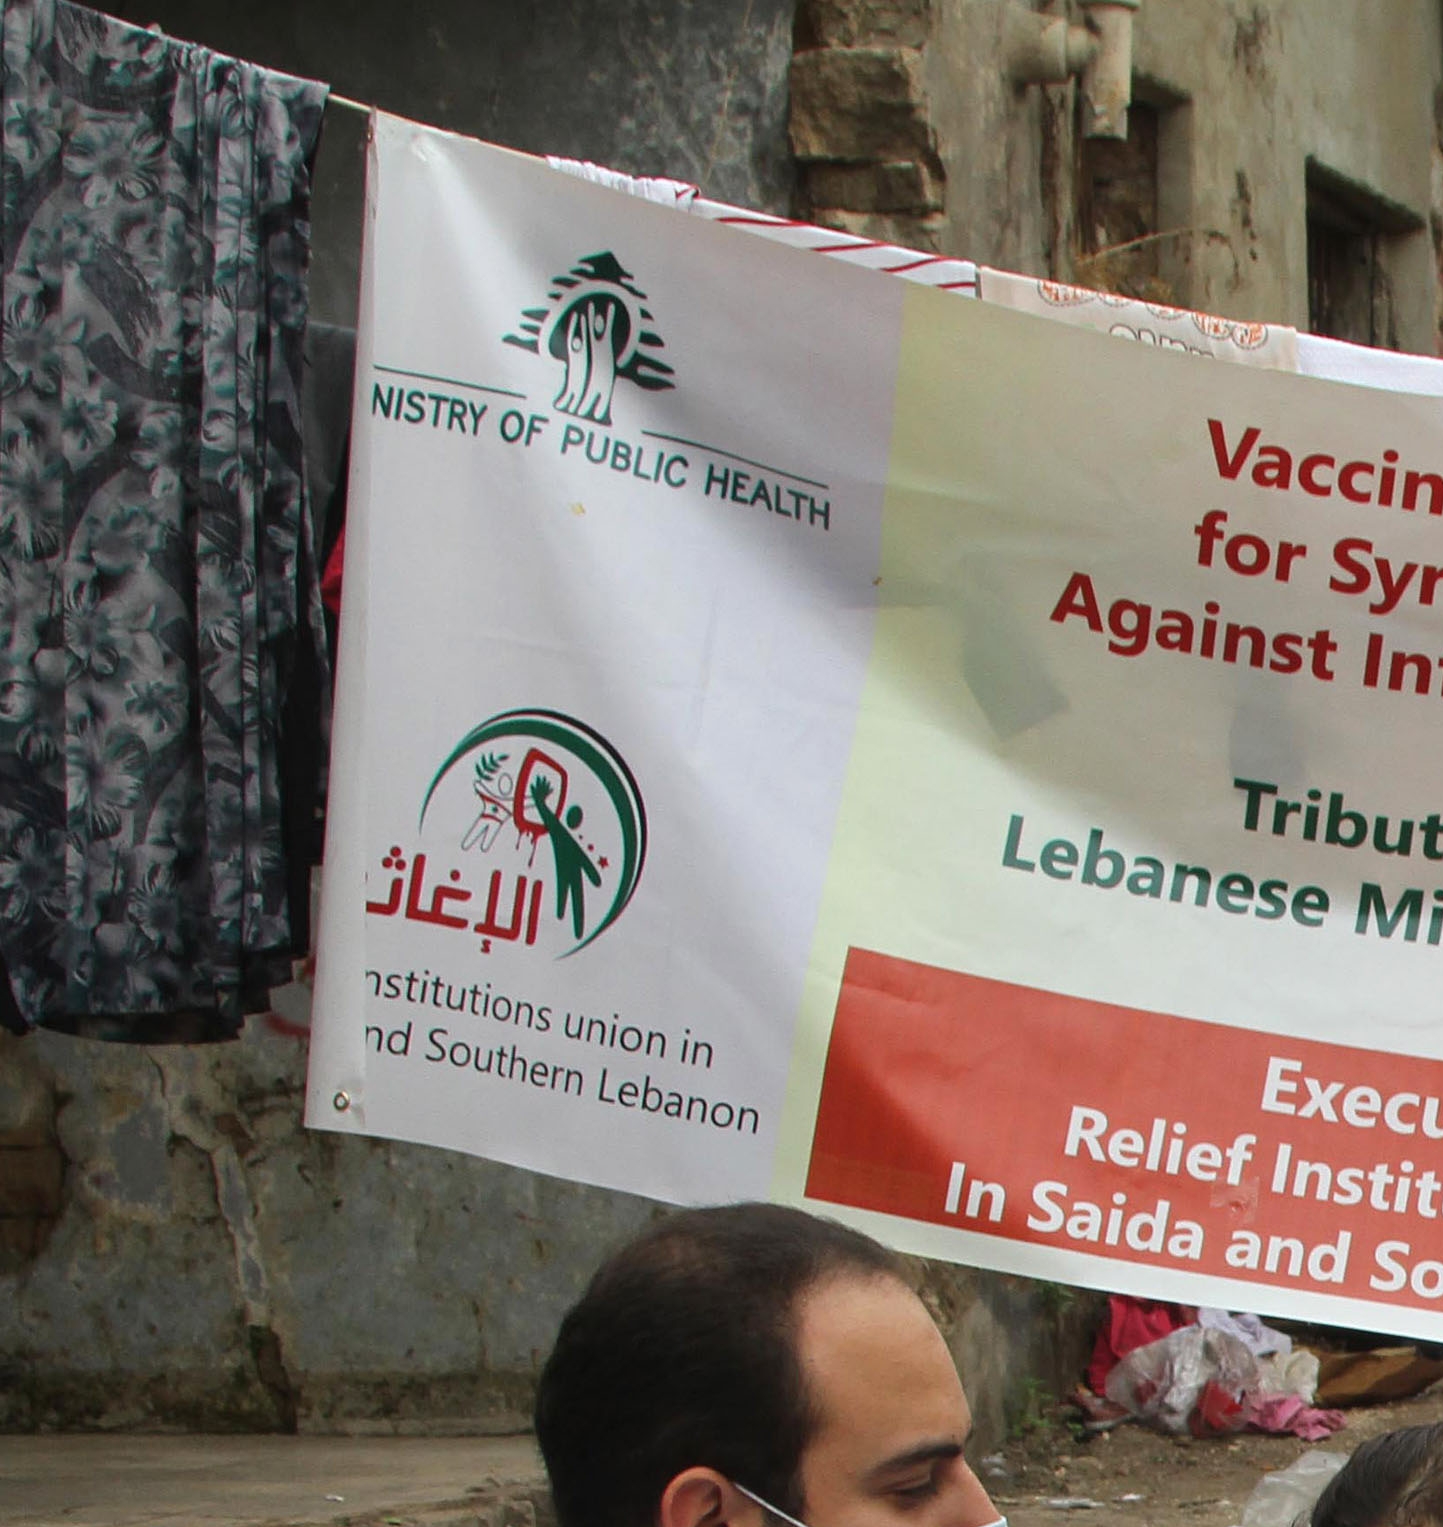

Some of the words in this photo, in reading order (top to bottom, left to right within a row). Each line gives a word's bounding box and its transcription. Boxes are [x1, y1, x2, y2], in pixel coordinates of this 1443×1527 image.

[372, 383, 488, 437] NISTRY
[500, 410, 549, 447] OF
[561, 424, 689, 488] PUBLIC
[705, 463, 830, 531] HEALTH
[1196, 512, 1307, 582] for
[1053, 575, 1337, 681] Against
[1002, 814, 1329, 927] Lebanese
[425, 1028, 583, 1096] Southern
[598, 1068, 758, 1134] Lebanon
[565, 1013, 666, 1058] union
[681, 1028, 713, 1068] in
[1065, 1106, 1257, 1186] Relief
[946, 1162, 1005, 1221] In
[1027, 1181, 1204, 1260] Saida
[1225, 1230, 1352, 1284] and
